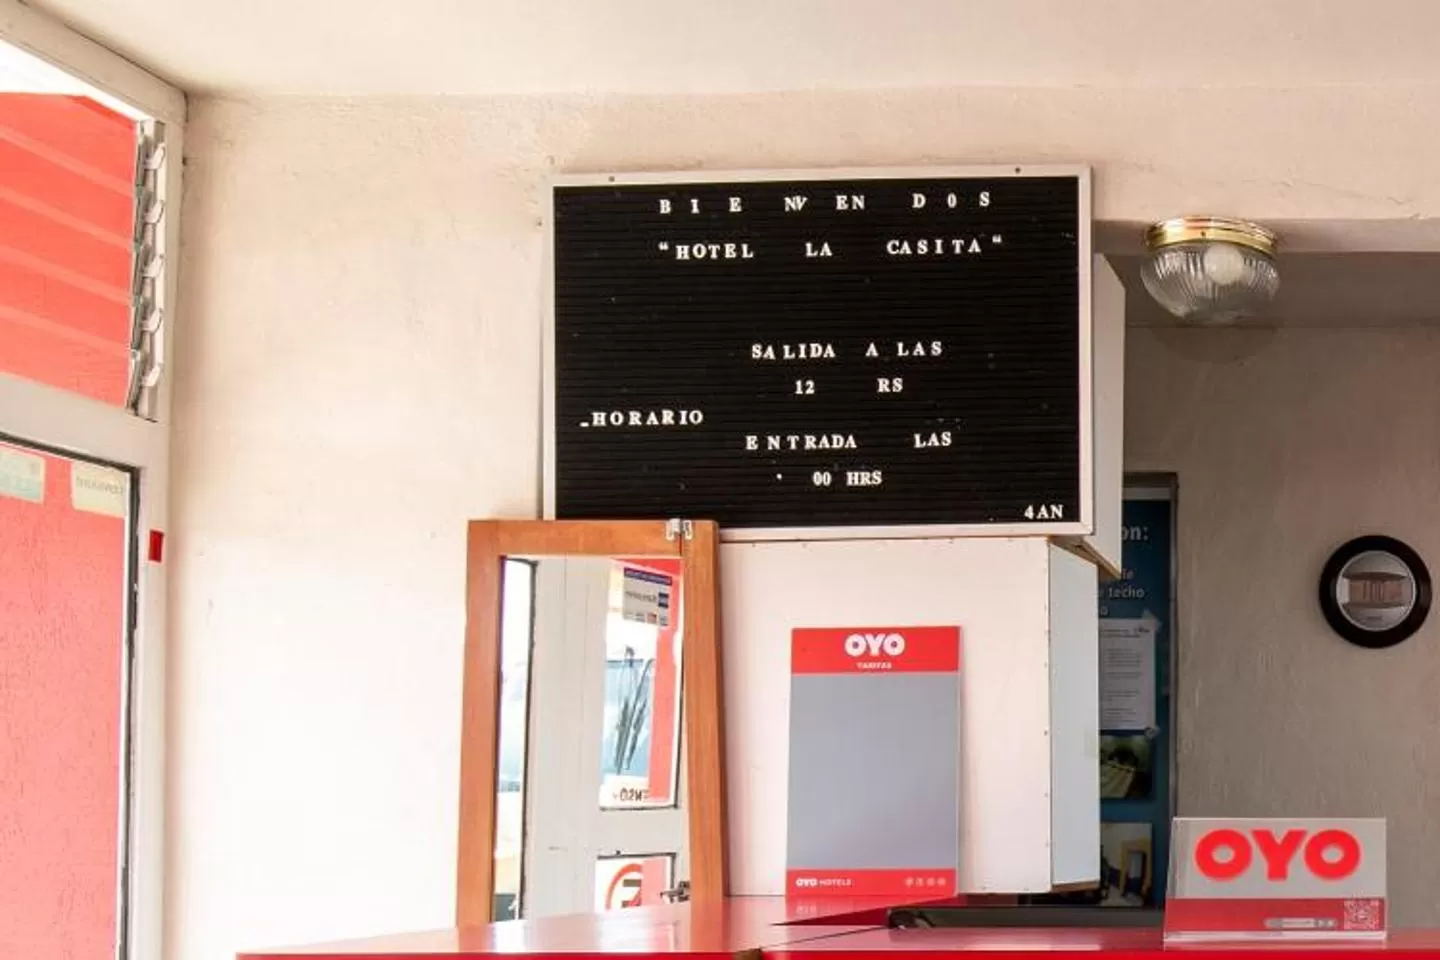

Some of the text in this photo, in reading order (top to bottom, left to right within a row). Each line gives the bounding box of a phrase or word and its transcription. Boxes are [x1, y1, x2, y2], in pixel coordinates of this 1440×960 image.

[806, 243, 832, 256] LA
[752, 341, 941, 359] SALIDA A LAS
[796, 378, 903, 394] 12 RS
[746, 432, 951, 450] ENTRADA LAS
[847, 471, 882, 485] HRS
[845, 633, 905, 656] OYO
[1195, 828, 1361, 882] OYO
[796, 878, 818, 887] OYO
